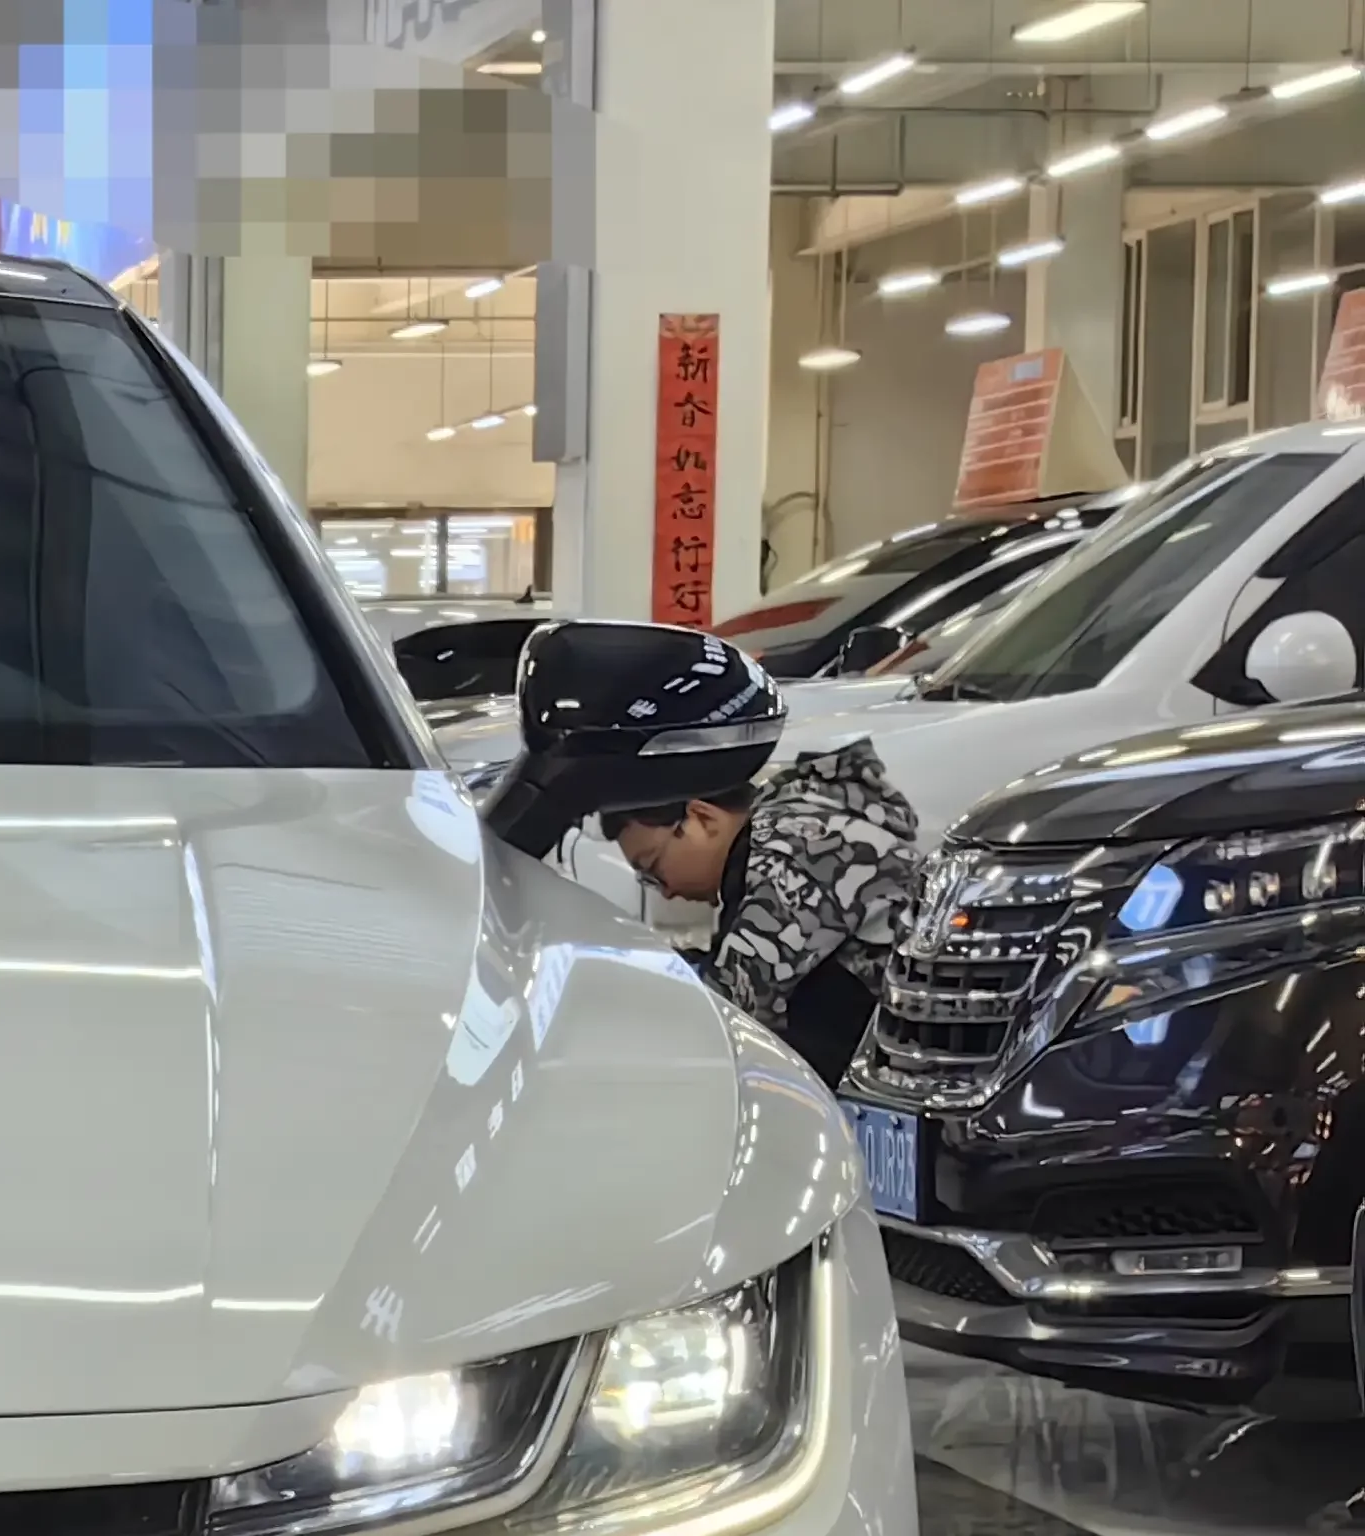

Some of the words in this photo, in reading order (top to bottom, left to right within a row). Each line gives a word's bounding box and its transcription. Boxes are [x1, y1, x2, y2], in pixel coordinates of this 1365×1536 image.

[669, 342, 713, 630] 新春如意行好
